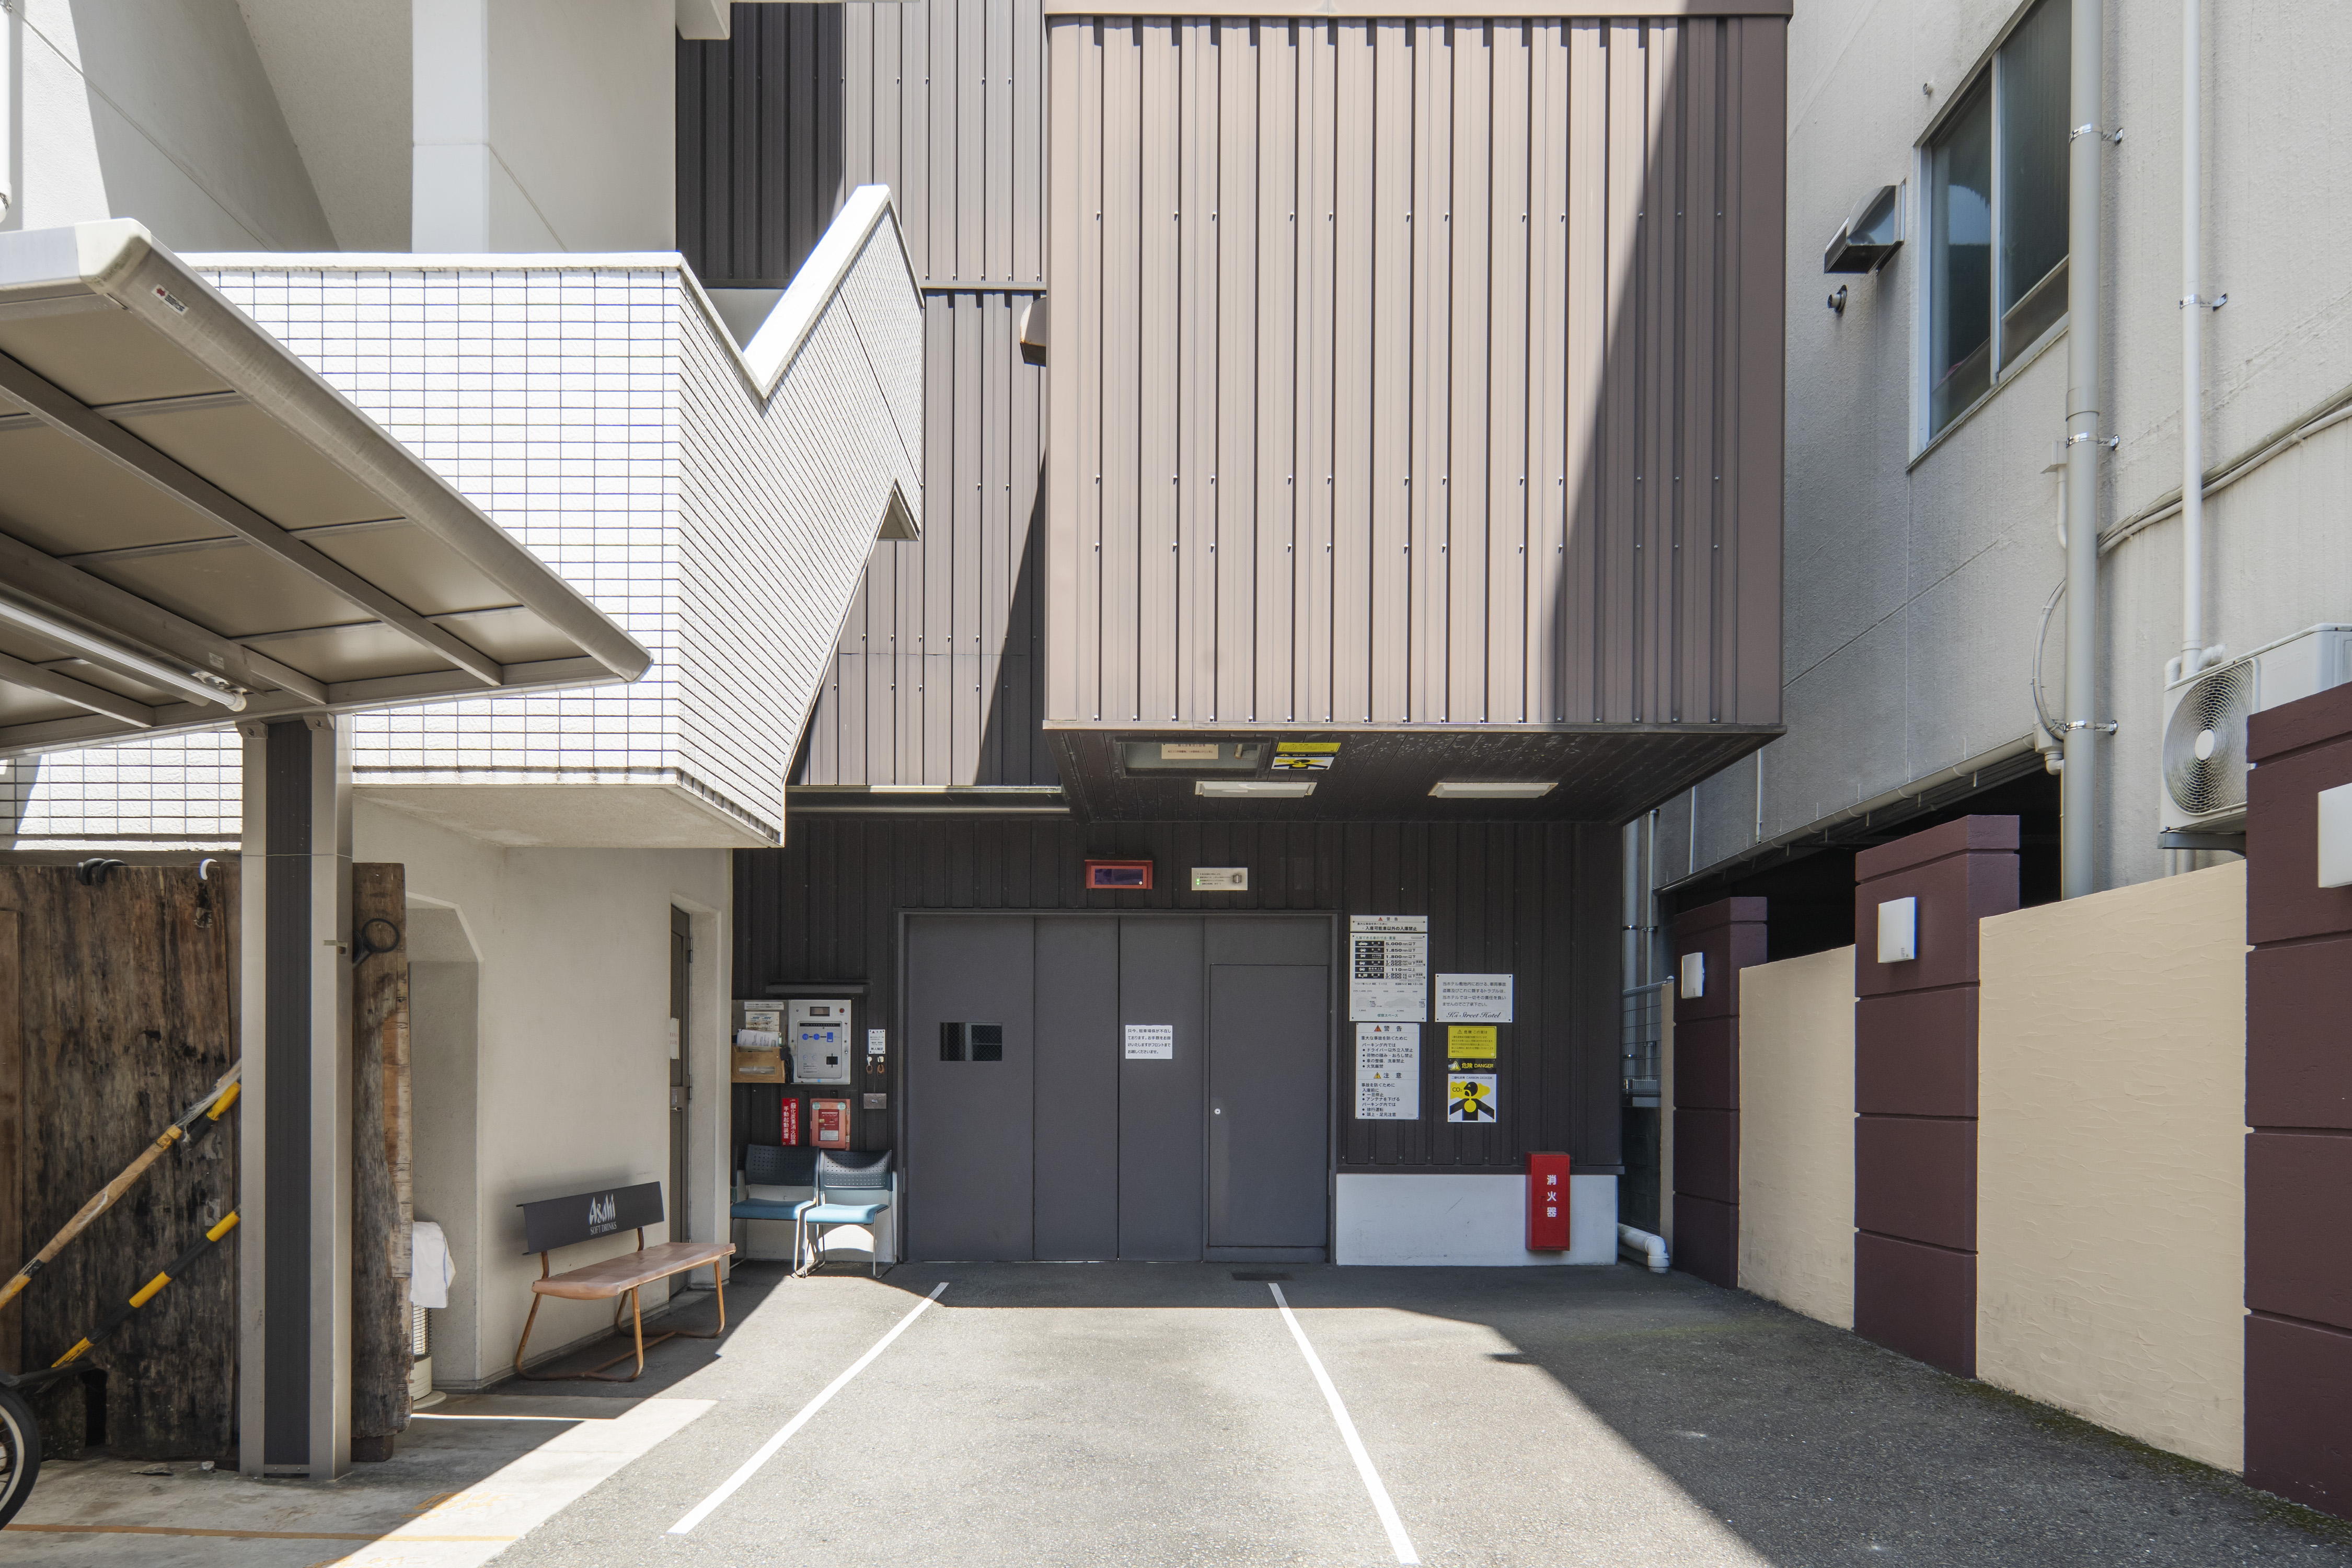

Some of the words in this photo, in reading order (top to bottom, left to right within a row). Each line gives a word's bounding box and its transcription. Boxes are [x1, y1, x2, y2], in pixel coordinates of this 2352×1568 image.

[589, 1193, 616, 1225] Asahi
[1547, 1174, 1557, 1217] 消火器
[590, 1225, 601, 1235] SOFT
[602, 1221, 617, 1232] DRINKS
